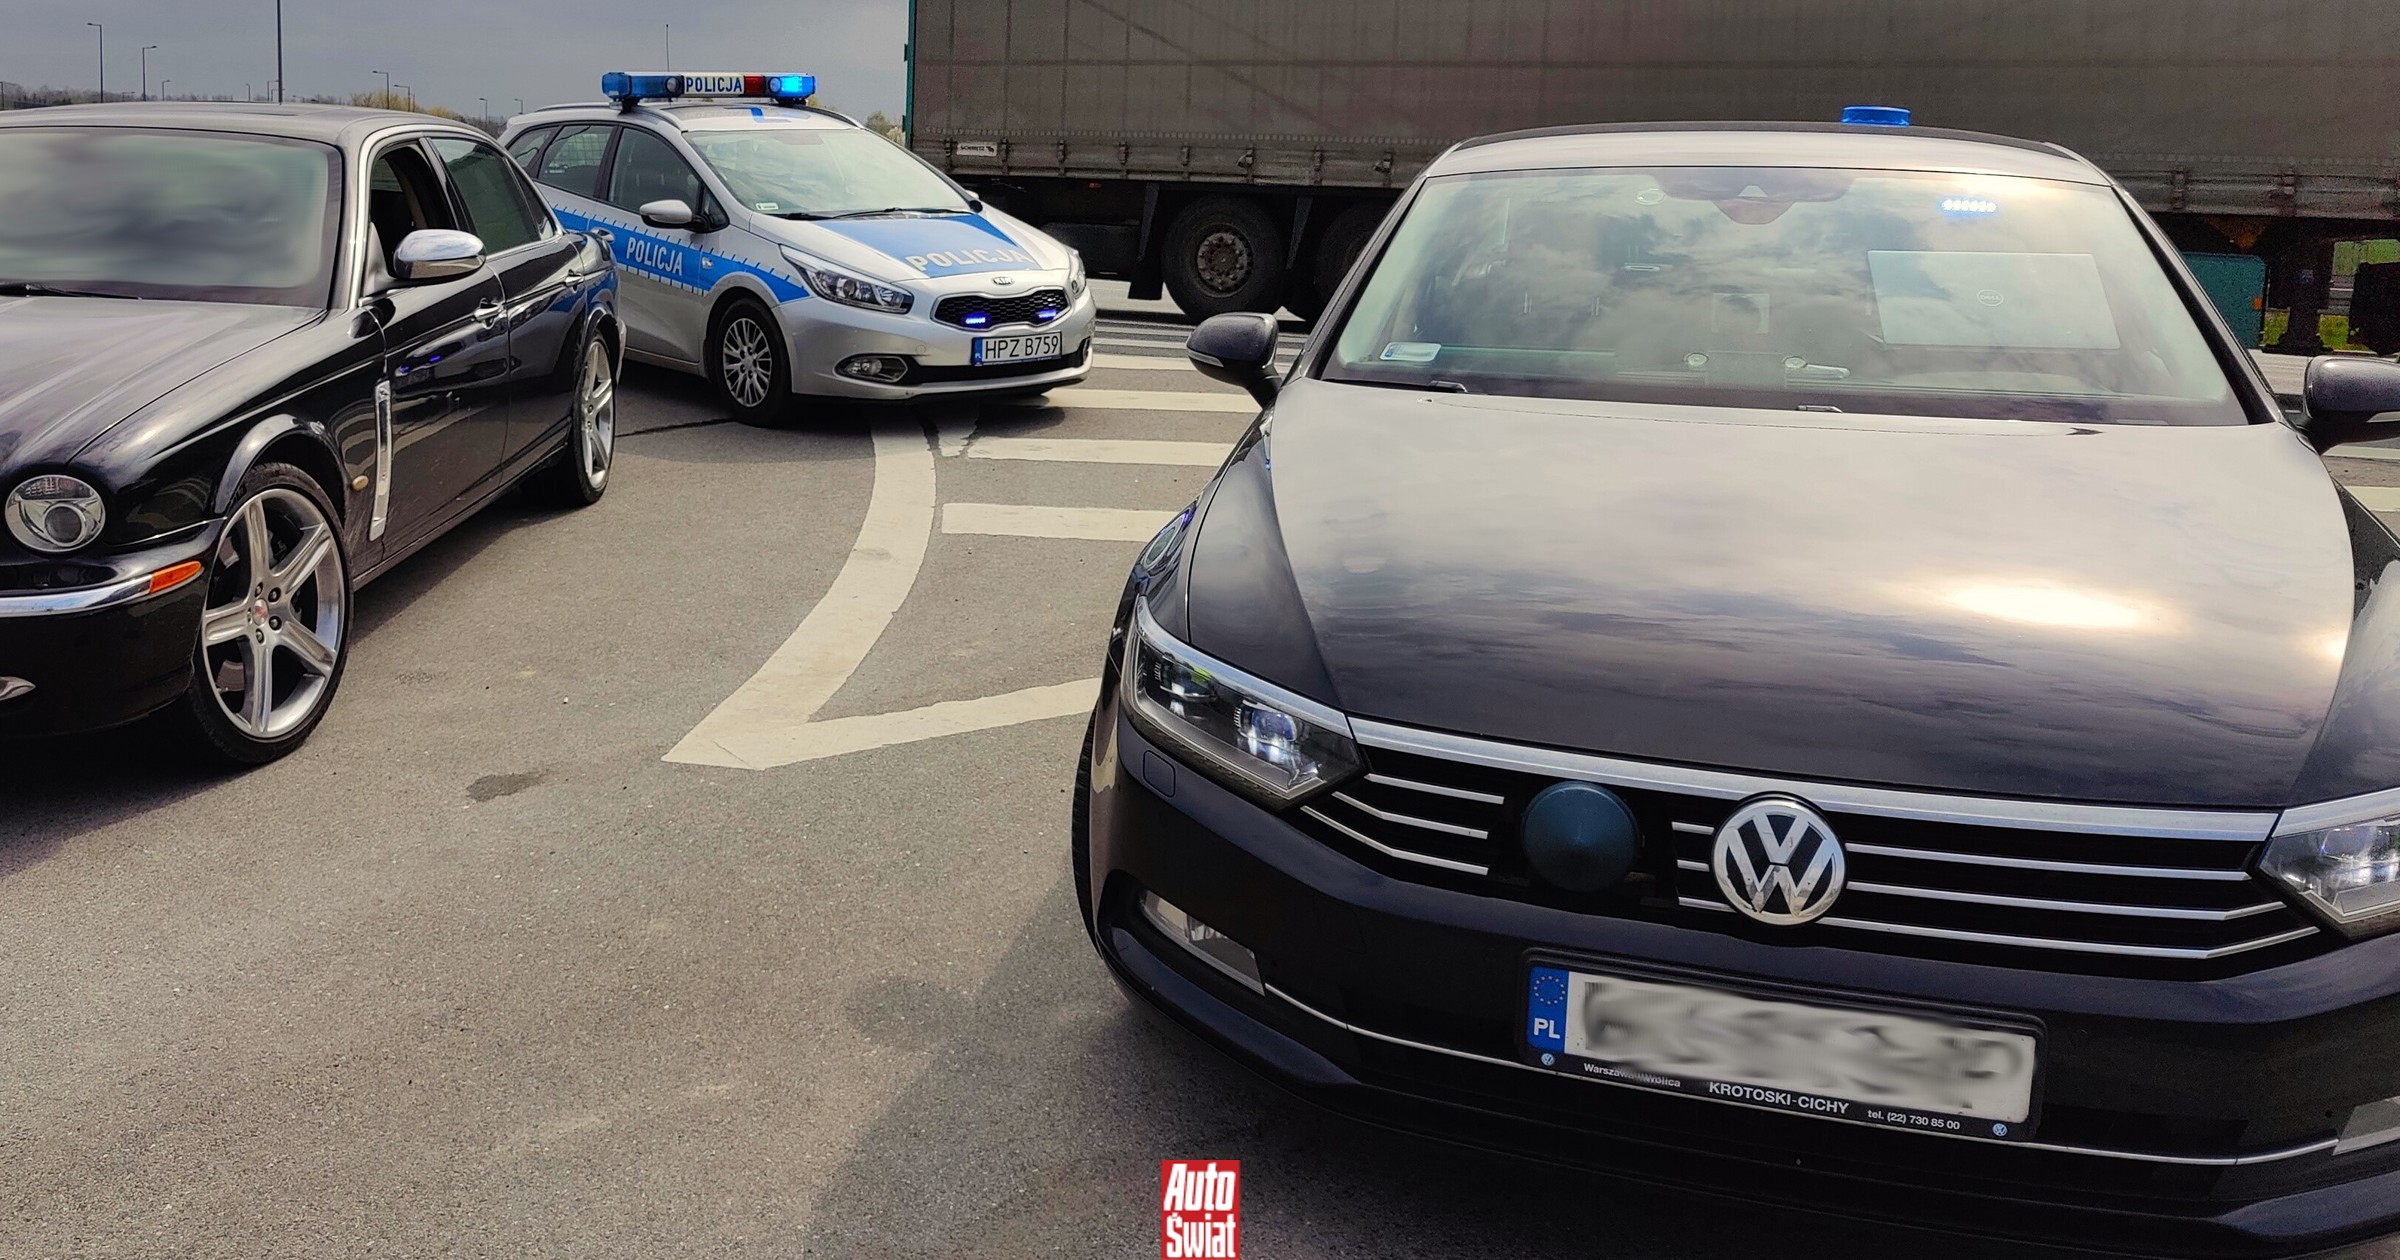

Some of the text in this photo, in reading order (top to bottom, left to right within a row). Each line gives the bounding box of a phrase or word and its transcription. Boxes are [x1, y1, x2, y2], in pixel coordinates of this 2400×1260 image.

[685, 76, 743, 93] POLICJA
[626, 236, 683, 276] POLICJA
[904, 249, 1035, 272] POLICJA
[985, 335, 1059, 360] HPZ B759
[1533, 1017, 1561, 1040] PL
[1708, 1081, 1850, 1115] KROTOSKI-CICHY
[1867, 1109, 1961, 1130] tel. (22) 730 85 00
